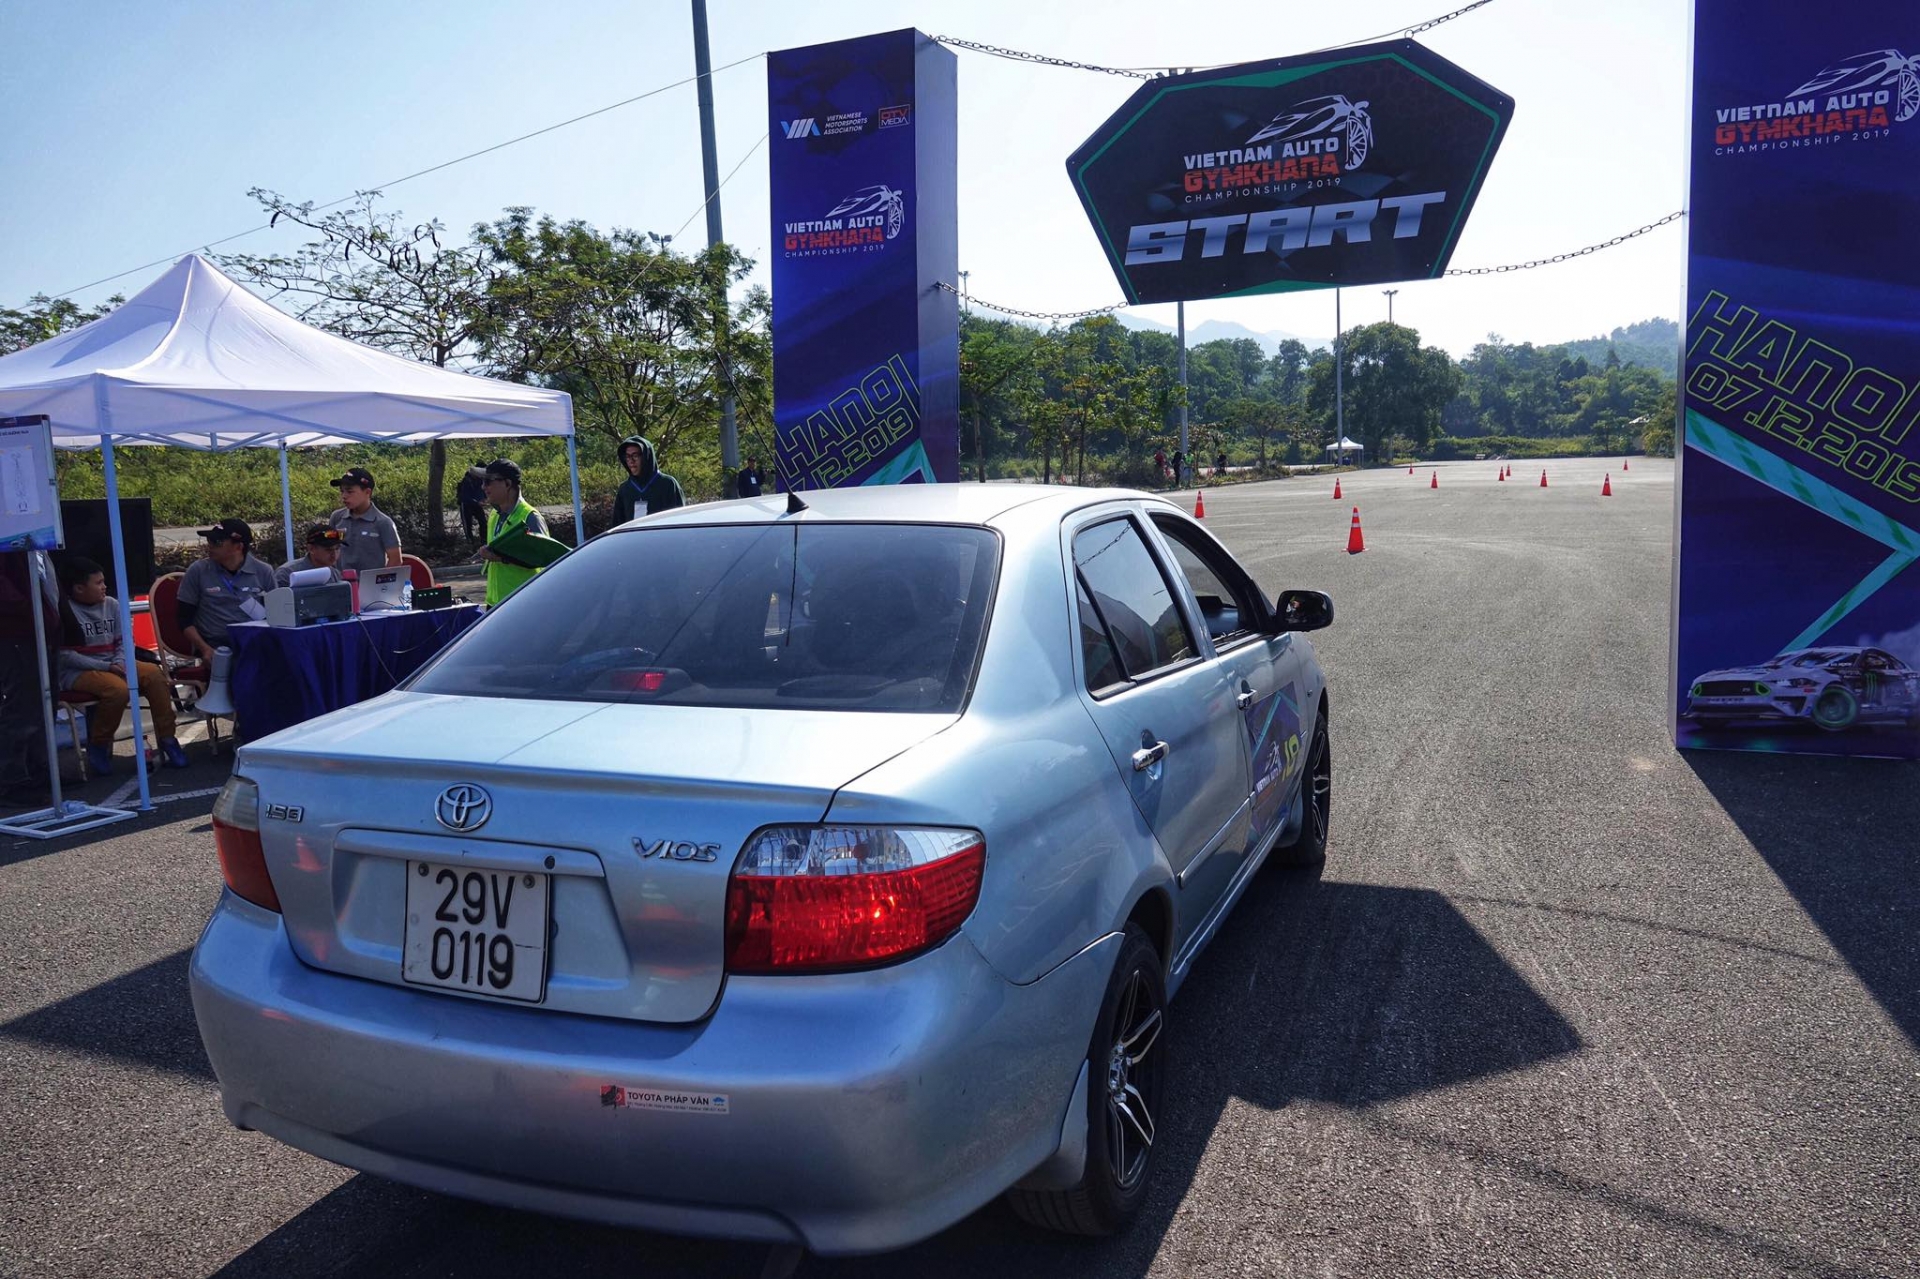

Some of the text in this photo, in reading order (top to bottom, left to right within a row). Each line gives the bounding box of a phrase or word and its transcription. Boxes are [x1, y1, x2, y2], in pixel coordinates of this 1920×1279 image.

[827, 111, 862, 121] VIETNAMESE
[1716, 90, 1890, 123] VIETNAM AUTO
[824, 125, 863, 135] ASSOCIATION
[825, 118, 868, 128] MOTORSPORTS
[1715, 106, 1889, 145] GYMKHANA
[1183, 137, 1339, 170] VIETNAM AUTO
[1715, 129, 1890, 156] CHAMPIONSHIP 2019
[1184, 153, 1340, 193] GYMKHANA
[1185, 177, 1341, 203] CHAMPIONSHIP 2019
[785, 215, 884, 233] VIETNAM AUTO
[1124, 191, 1446, 266] START
[785, 226, 884, 250] GYMKHANA
[785, 244, 884, 258] CHAMPIONSHIP 2019
[1687, 289, 1920, 446] HANOI
[775, 353, 920, 479] HANOI
[790, 407, 914, 490] 12.2019
[80, 619, 114, 636] REAT
[631, 836, 721, 862] VIOS
[435, 868, 515, 929] 29V
[431, 927, 514, 989] 0119
[627, 1091, 662, 1103] TOYOTA
[664, 1093, 688, 1104] PHÁP
